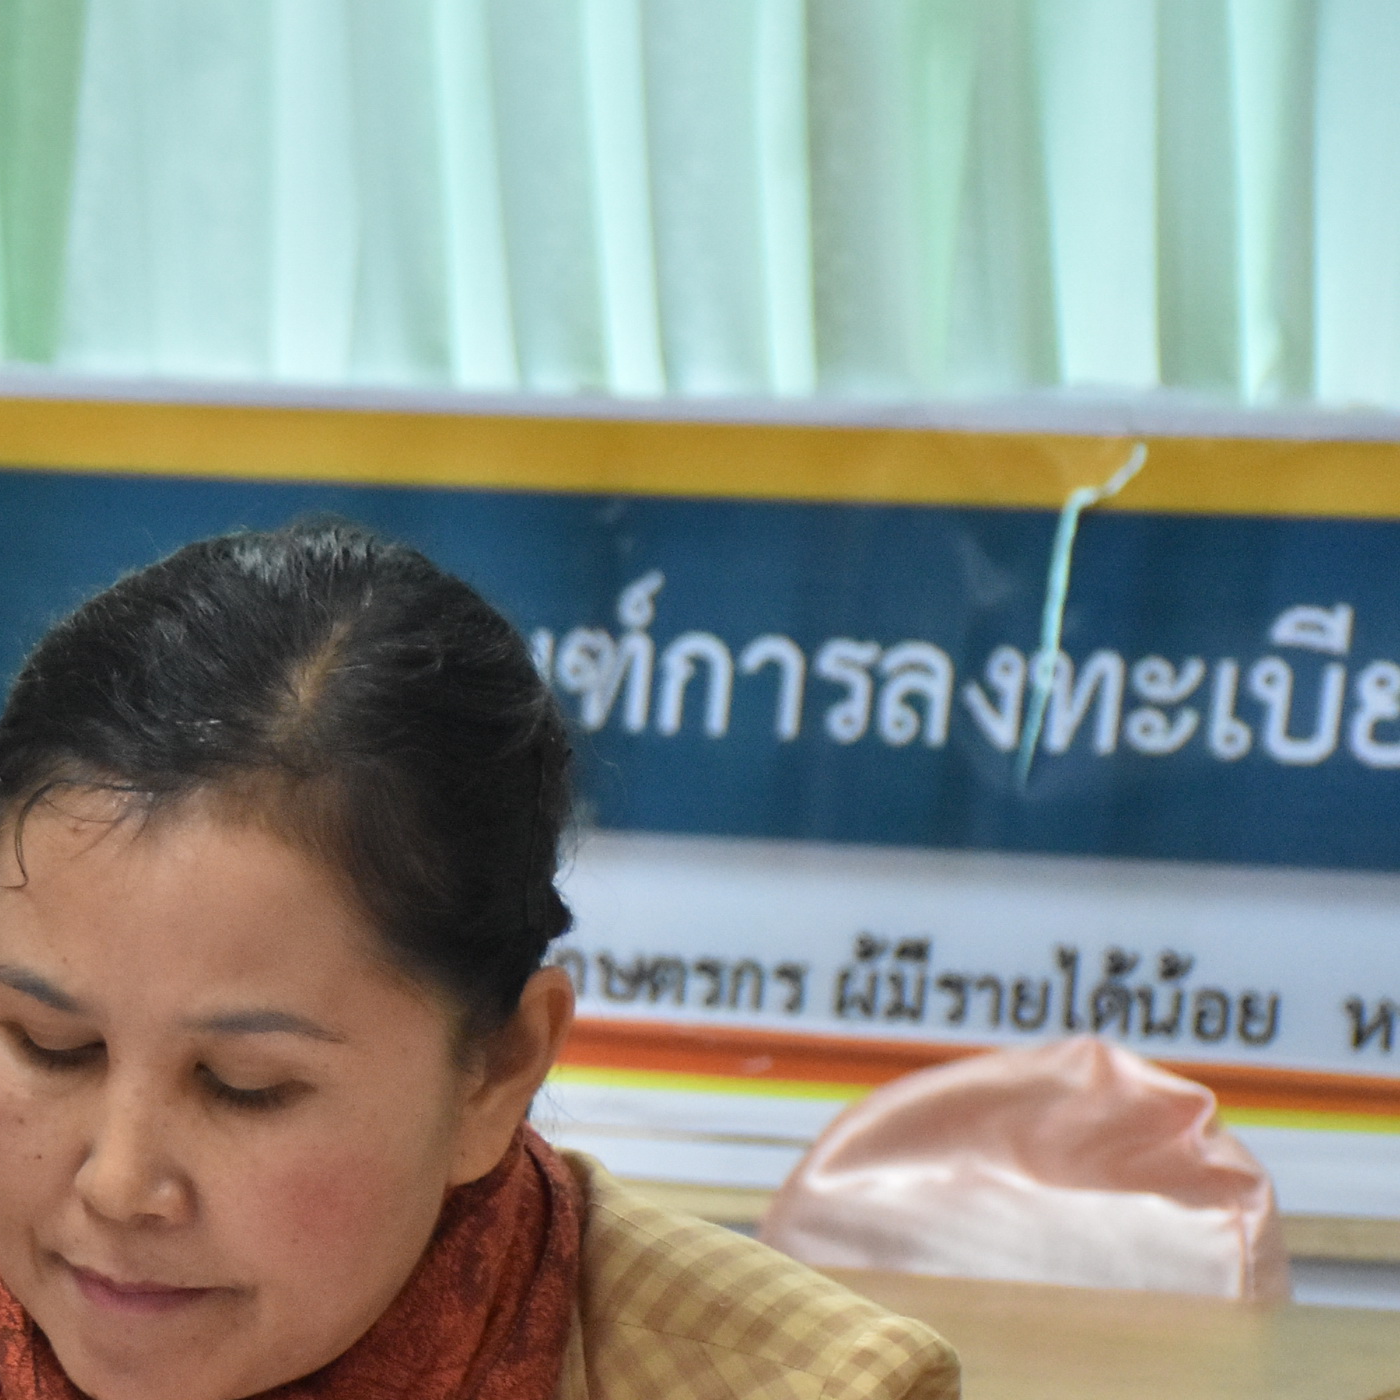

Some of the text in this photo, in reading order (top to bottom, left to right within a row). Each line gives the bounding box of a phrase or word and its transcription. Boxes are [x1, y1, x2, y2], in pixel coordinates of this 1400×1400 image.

[530, 568, 1400, 770] ฑ์การลงทะเบีย
